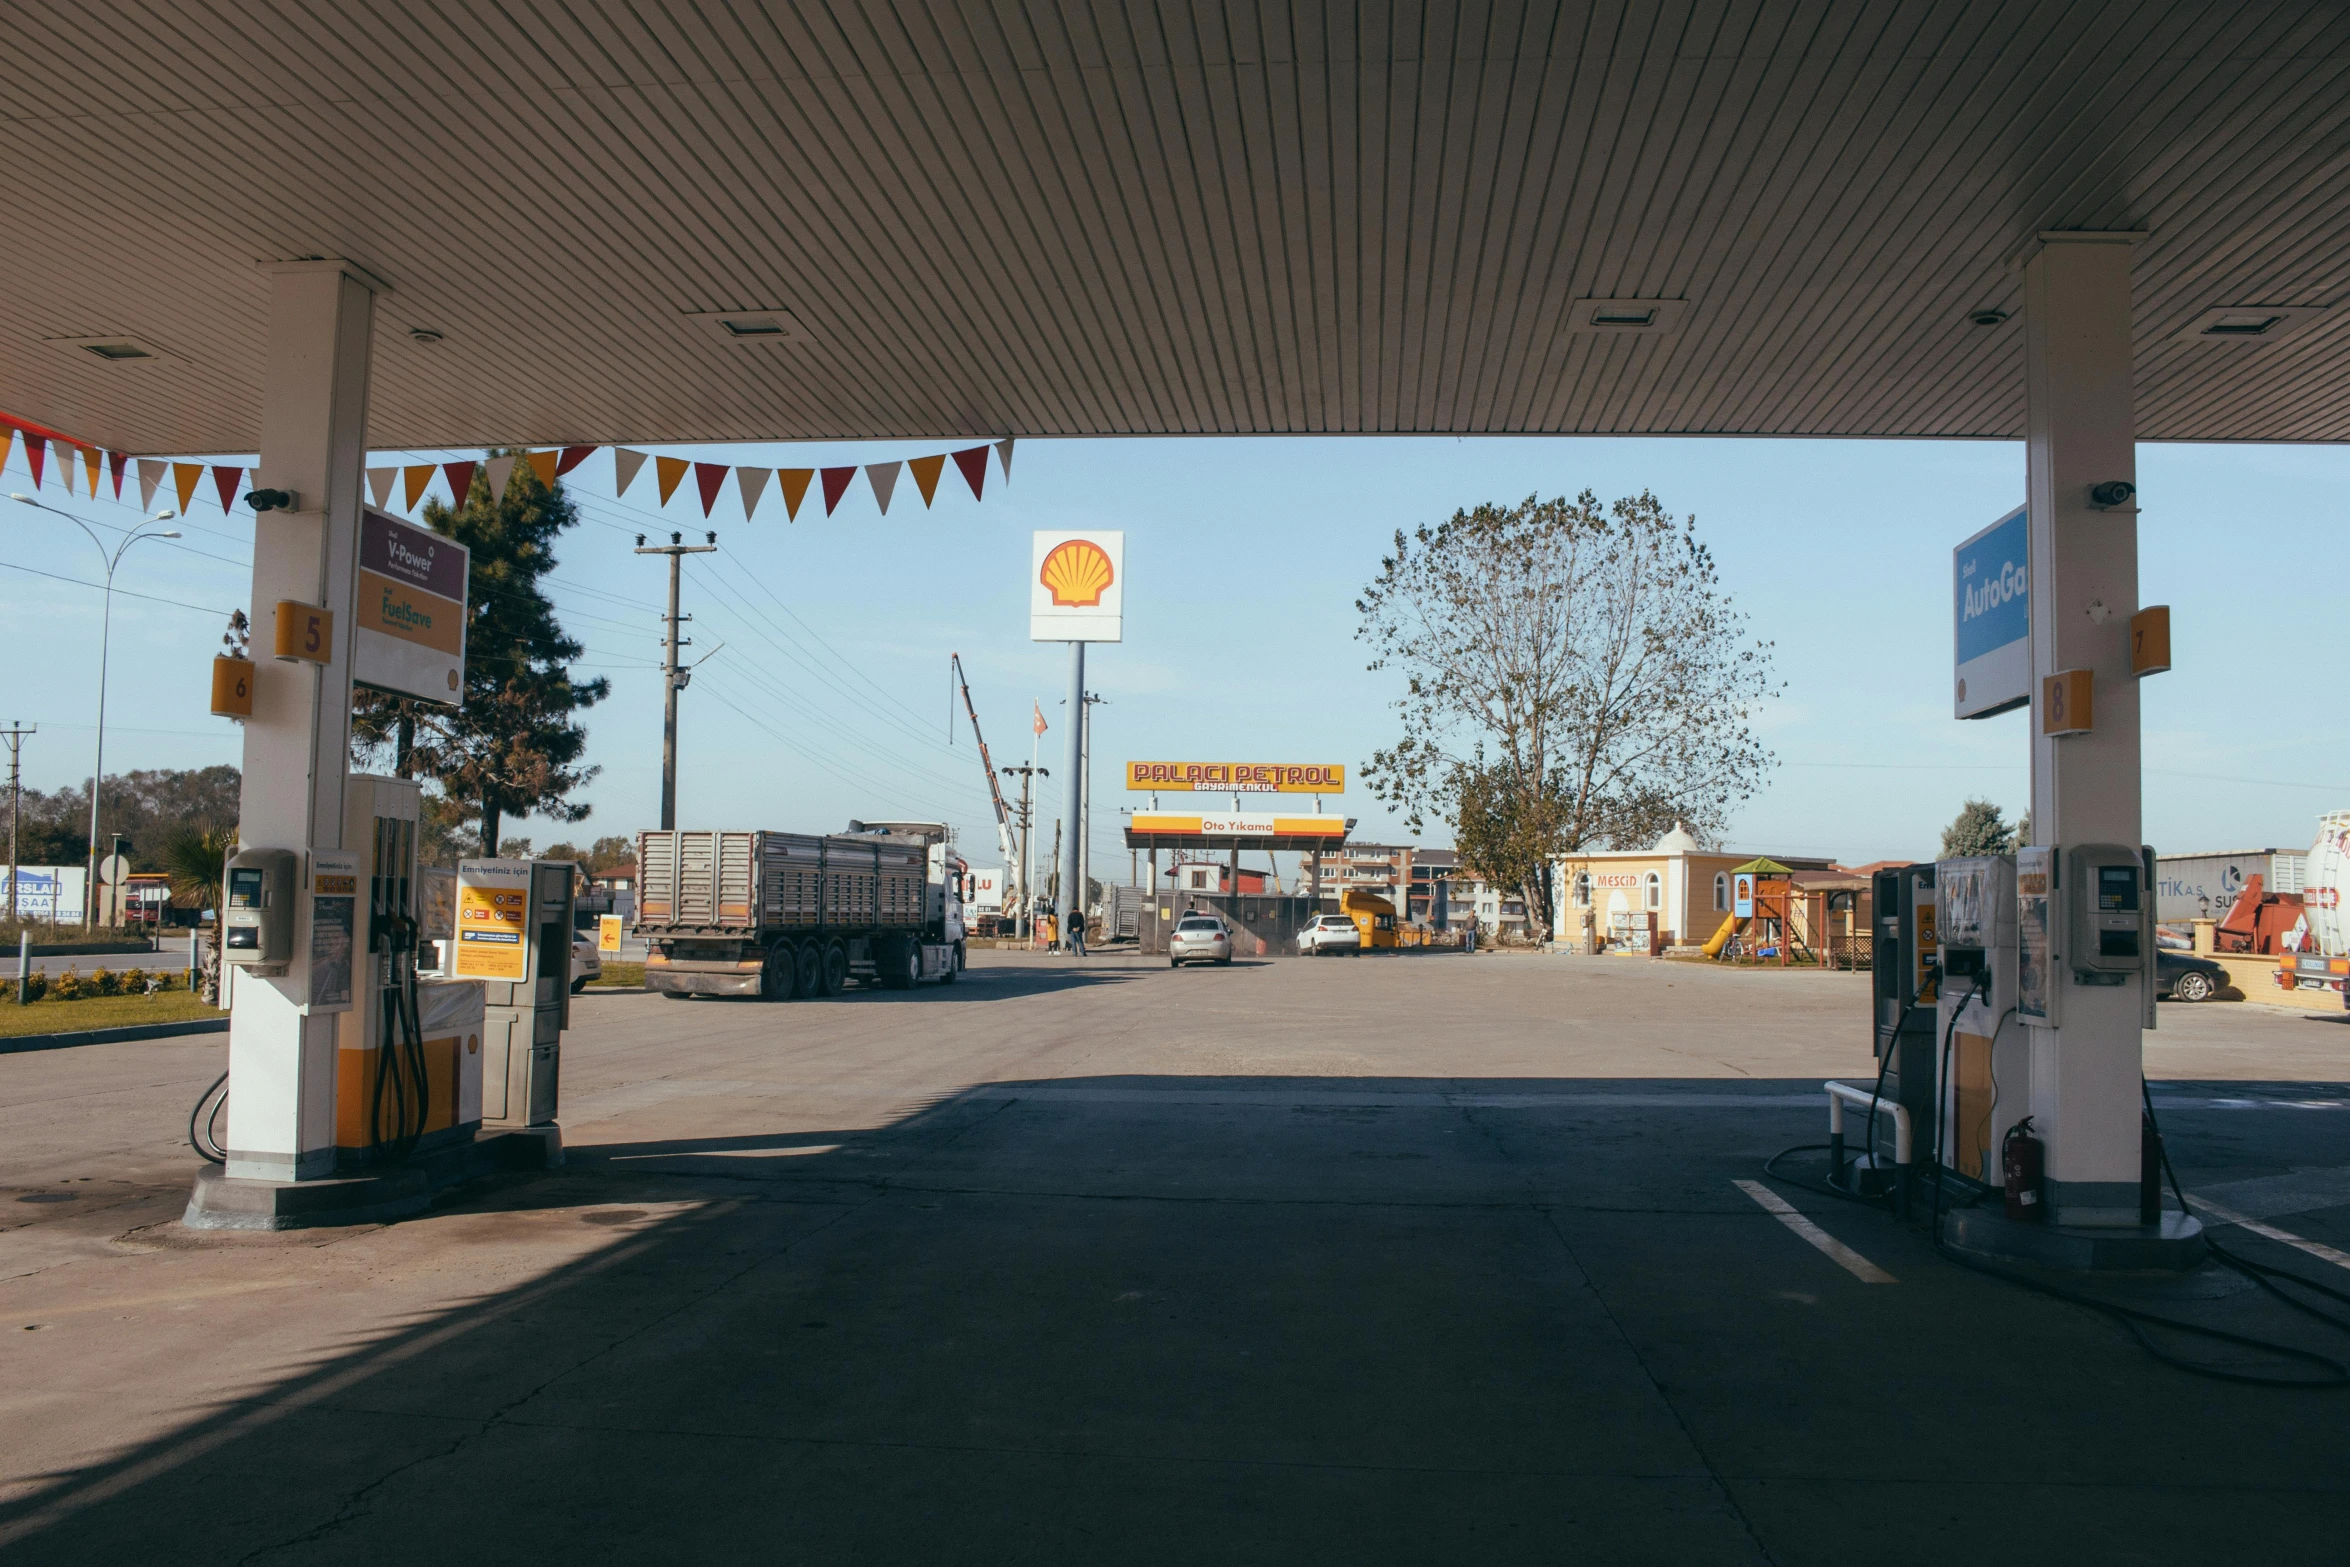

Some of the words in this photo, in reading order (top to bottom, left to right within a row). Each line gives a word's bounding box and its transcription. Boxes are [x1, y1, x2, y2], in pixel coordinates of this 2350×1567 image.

[388, 540, 432, 572] V-Power
[1964, 561, 2027, 622] AutoGa
[382, 596, 432, 629] FuelSave
[306, 616, 321, 653] 5
[2136, 630, 2143, 654] 7
[236, 677, 246, 698] 6
[2053, 682, 2064, 723] 8
[1133, 764, 1228, 783] PALACI
[1235, 765, 1340, 785] PETROL
[1203, 821, 1224, 831] Oto
[1229, 822, 1273, 832] Yıkama
[462, 866, 510, 875] Emniyetiniz
[513, 867, 528, 877] için
